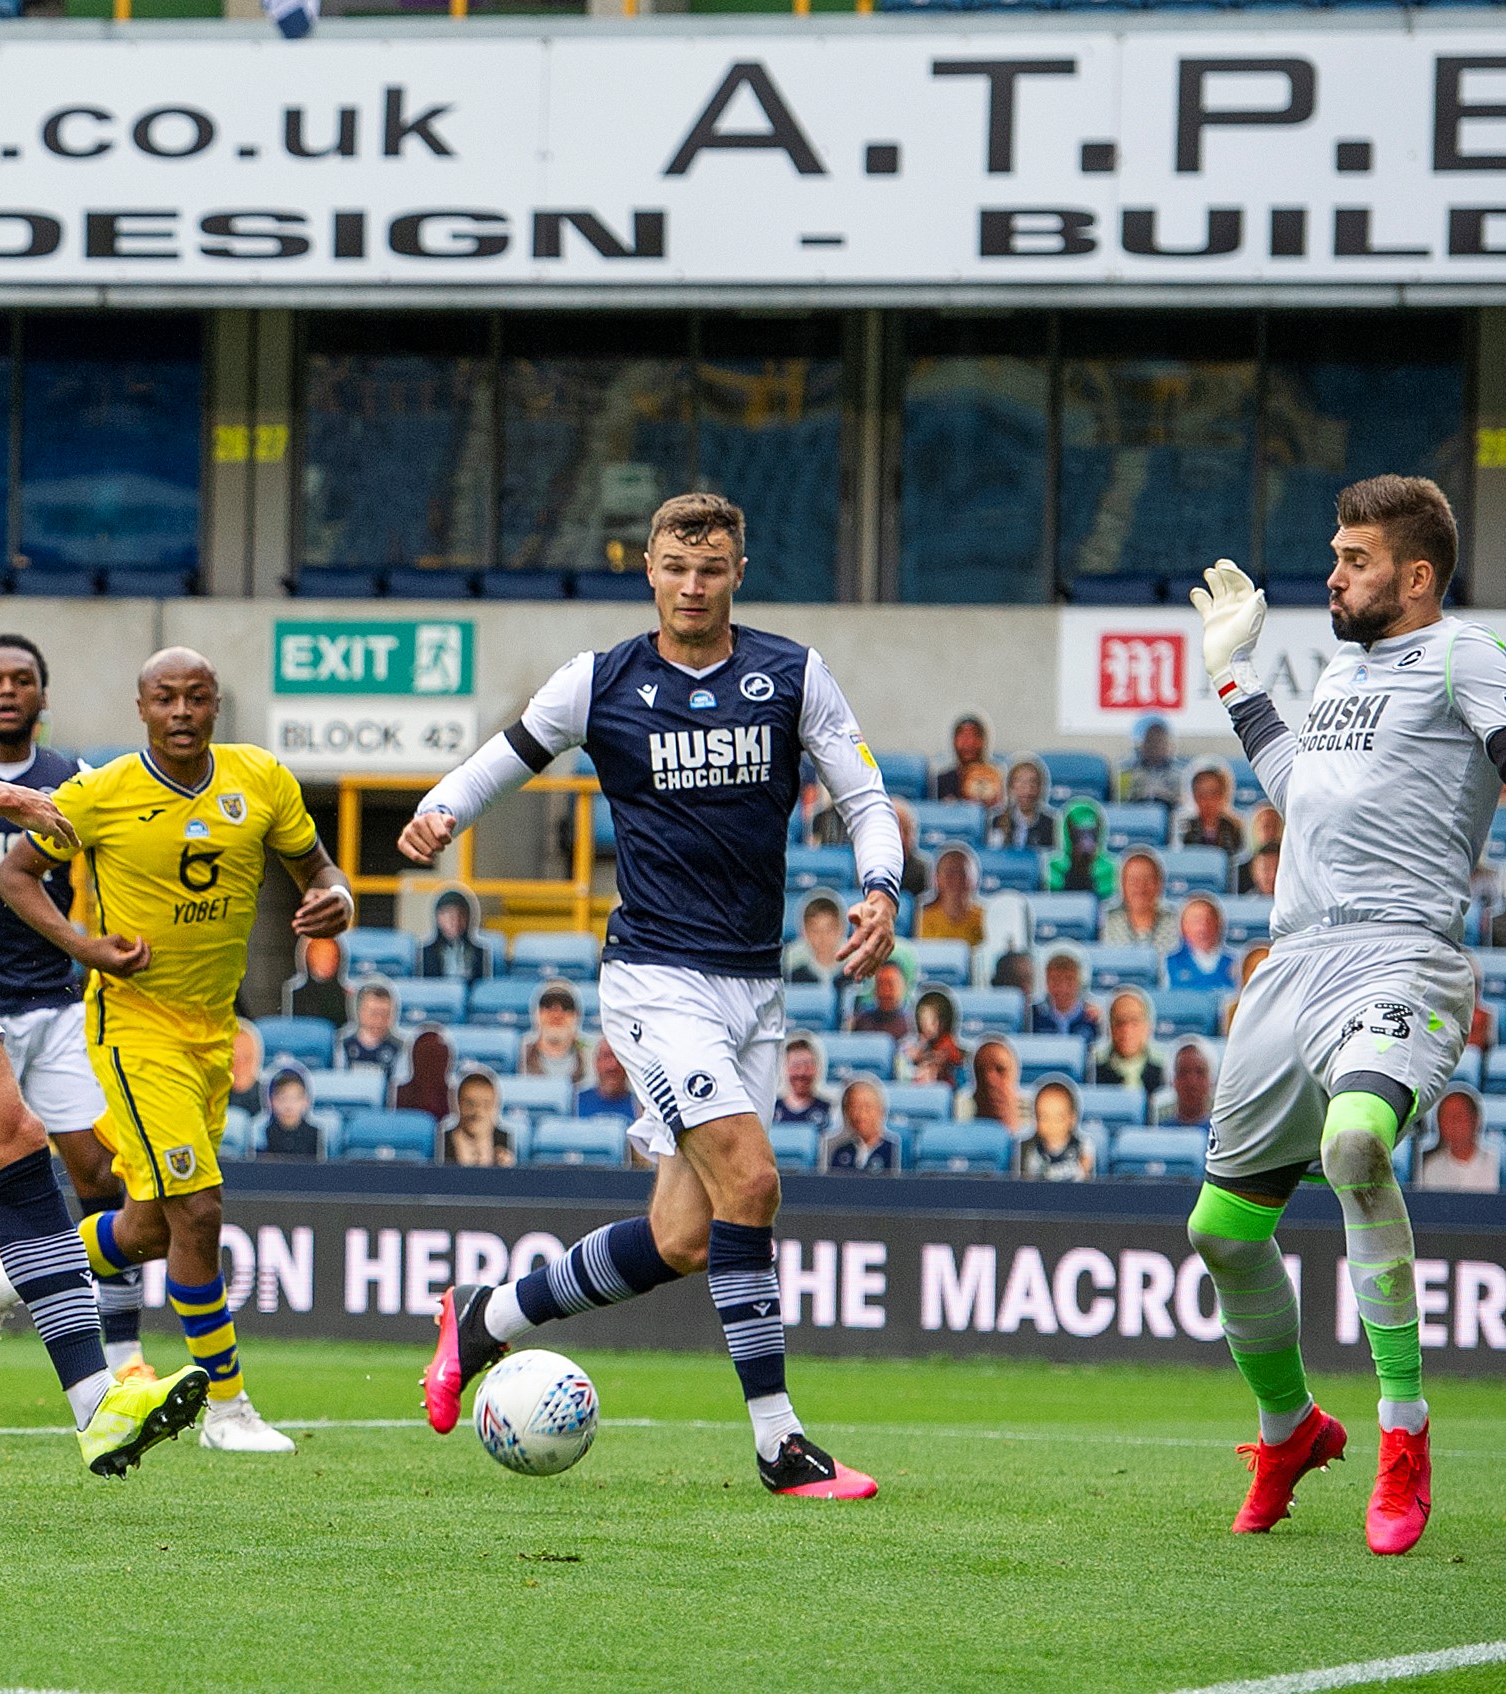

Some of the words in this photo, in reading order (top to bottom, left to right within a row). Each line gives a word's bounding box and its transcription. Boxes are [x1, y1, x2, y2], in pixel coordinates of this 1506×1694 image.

[281, 634, 400, 681] EXIT
[1301, 695, 1391, 735] HUSKI
[280, 720, 401, 752] BLOCK
[423, 722, 465, 752] 42
[649, 725, 771, 771] HUSKI
[653, 763, 771, 790] CHOCOLATE
[174, 896, 232, 925] YOBET
[771, 1239, 887, 1329] HE
[921, 1243, 1302, 1342] MACRO
